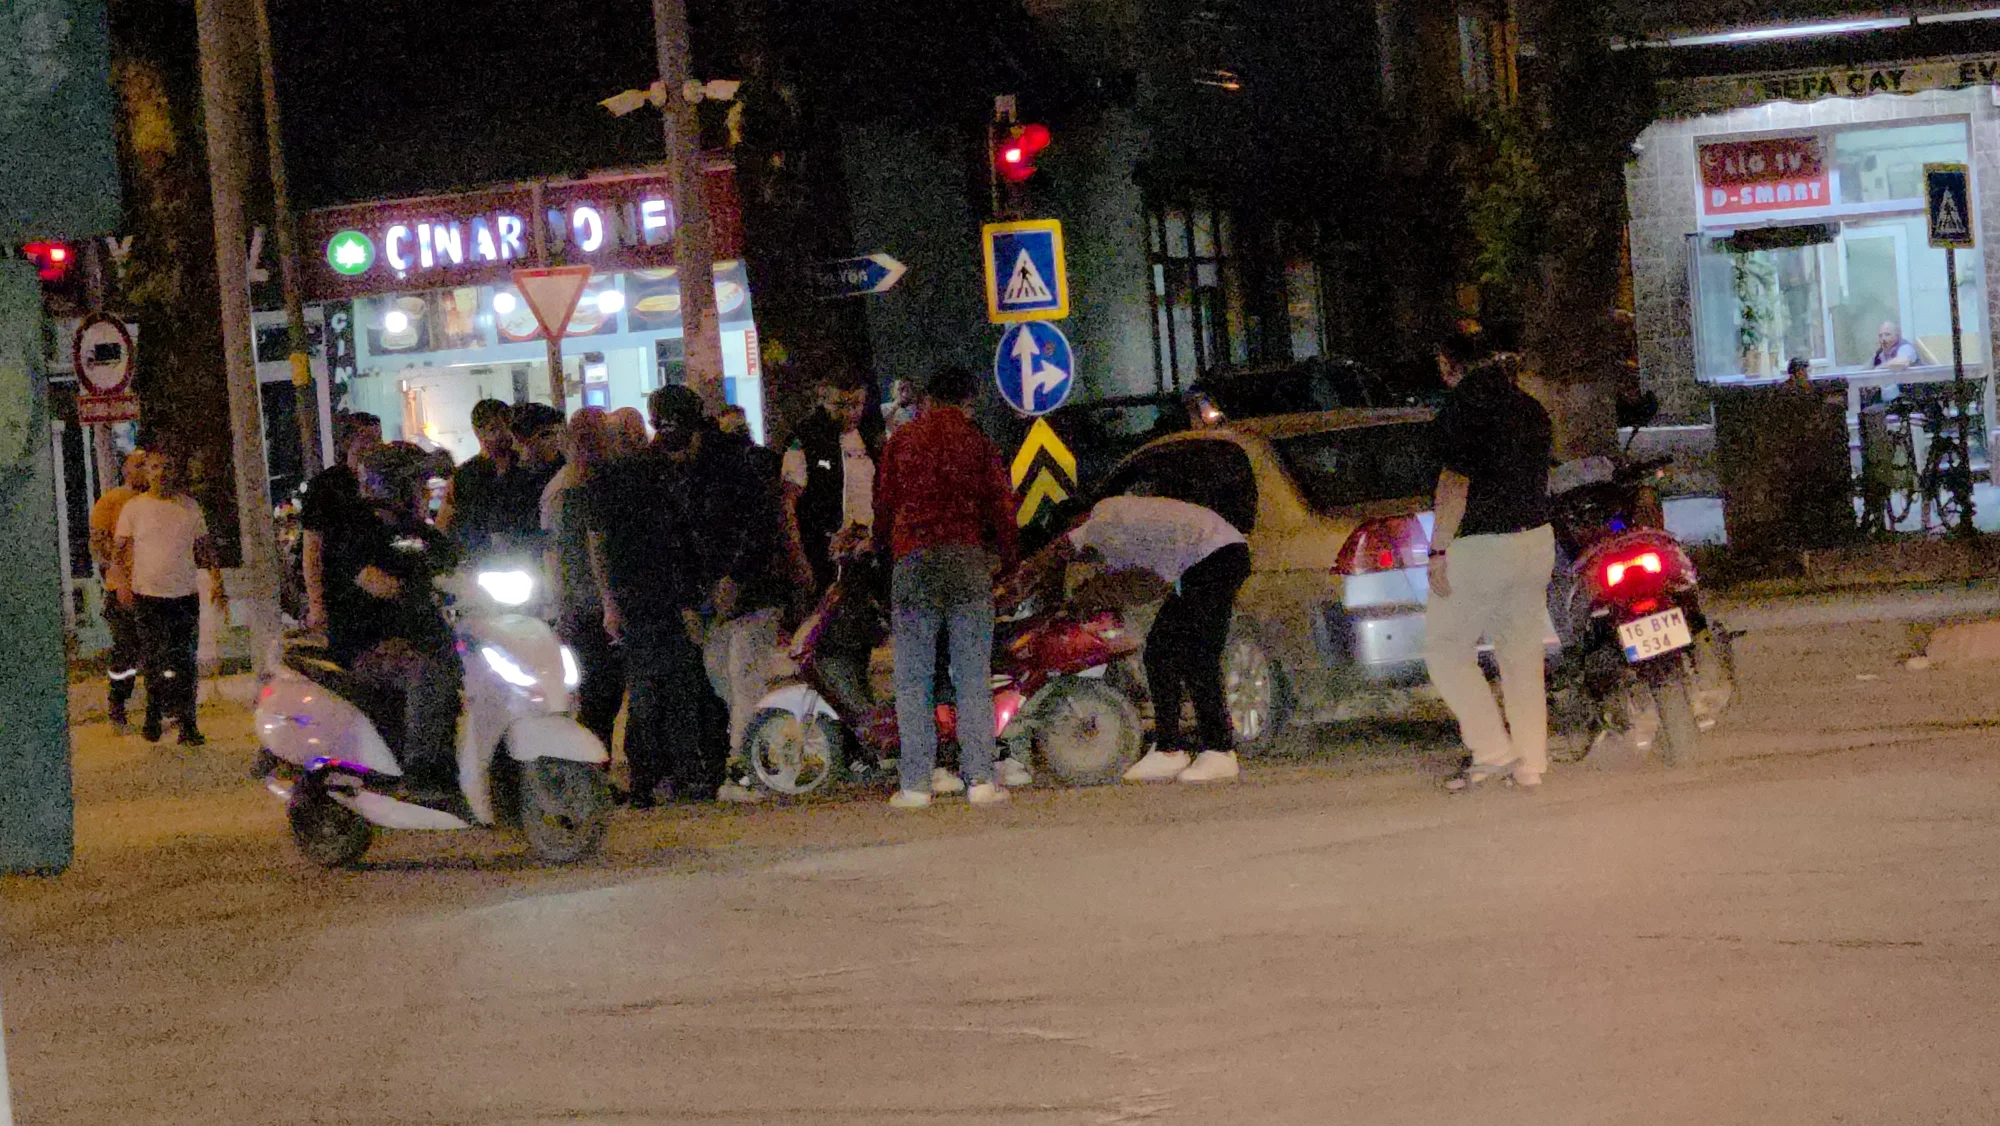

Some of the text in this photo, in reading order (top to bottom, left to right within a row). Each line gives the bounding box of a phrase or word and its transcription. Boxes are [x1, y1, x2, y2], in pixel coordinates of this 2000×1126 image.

[1625, 612, 1682, 641] 16 BYM
[1642, 633, 1672, 654] 534
